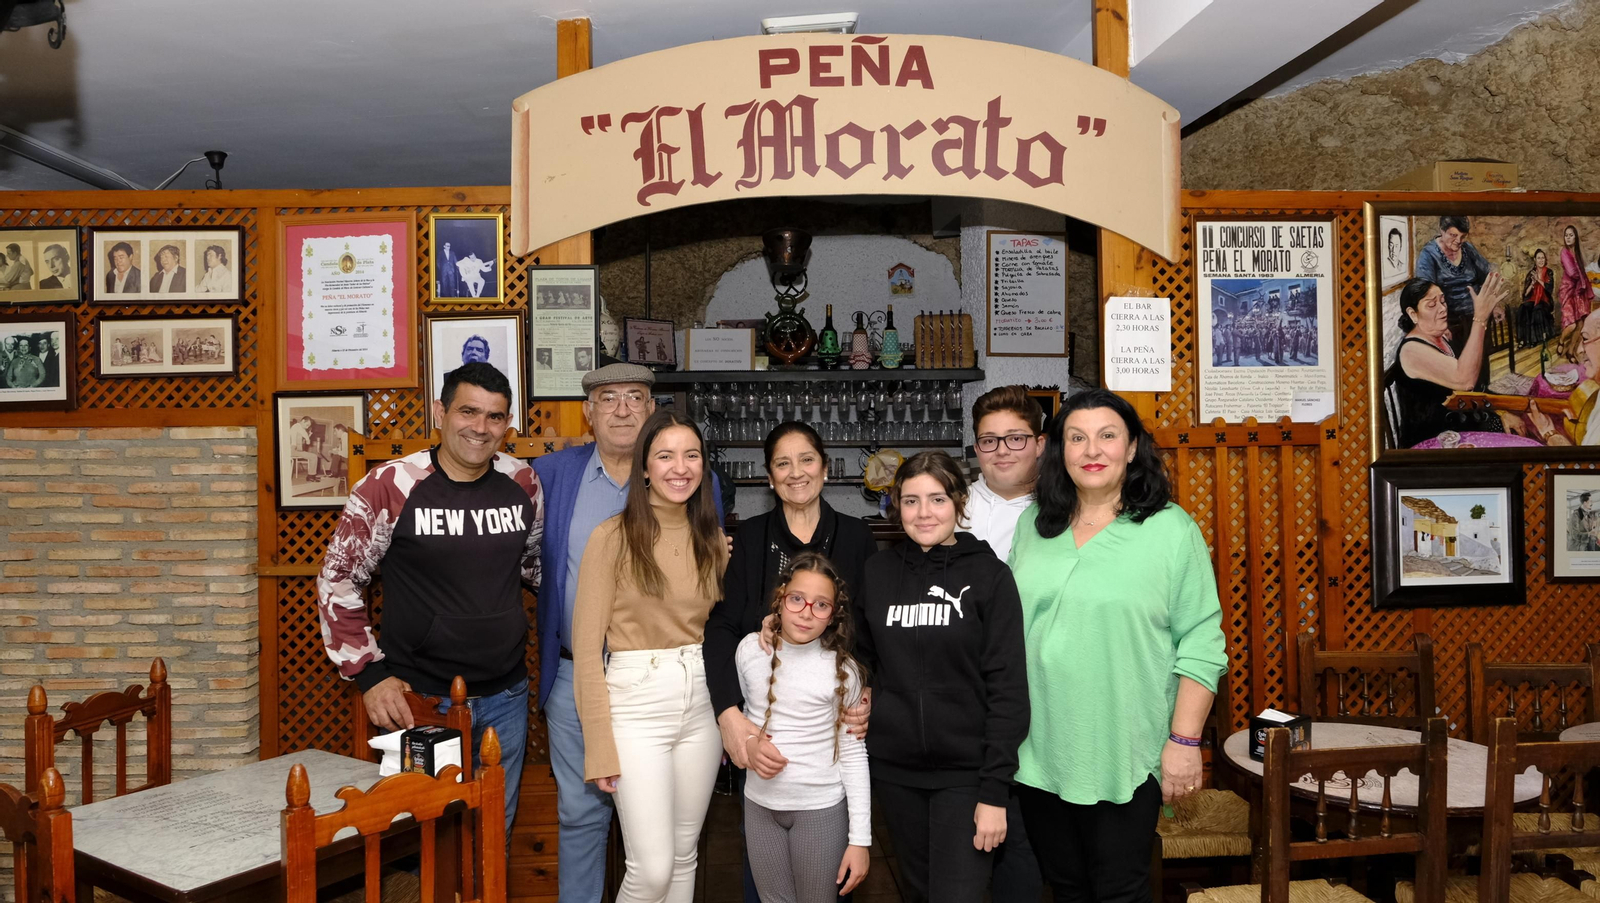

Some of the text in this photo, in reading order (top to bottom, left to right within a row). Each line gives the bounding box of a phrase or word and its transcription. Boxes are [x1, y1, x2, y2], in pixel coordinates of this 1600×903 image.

[758, 35, 935, 90] PEÑA
[1010, 238, 1039, 247] TAPAS
[1202, 225, 1324, 249] II CONCURSO DE SAETAS
[1203, 248, 1291, 273] PEÑA EL MORATO
[1134, 345, 1155, 353] PEÑA
[415, 505, 526, 535] NEW YORK
[886, 603, 951, 627] PUMA
